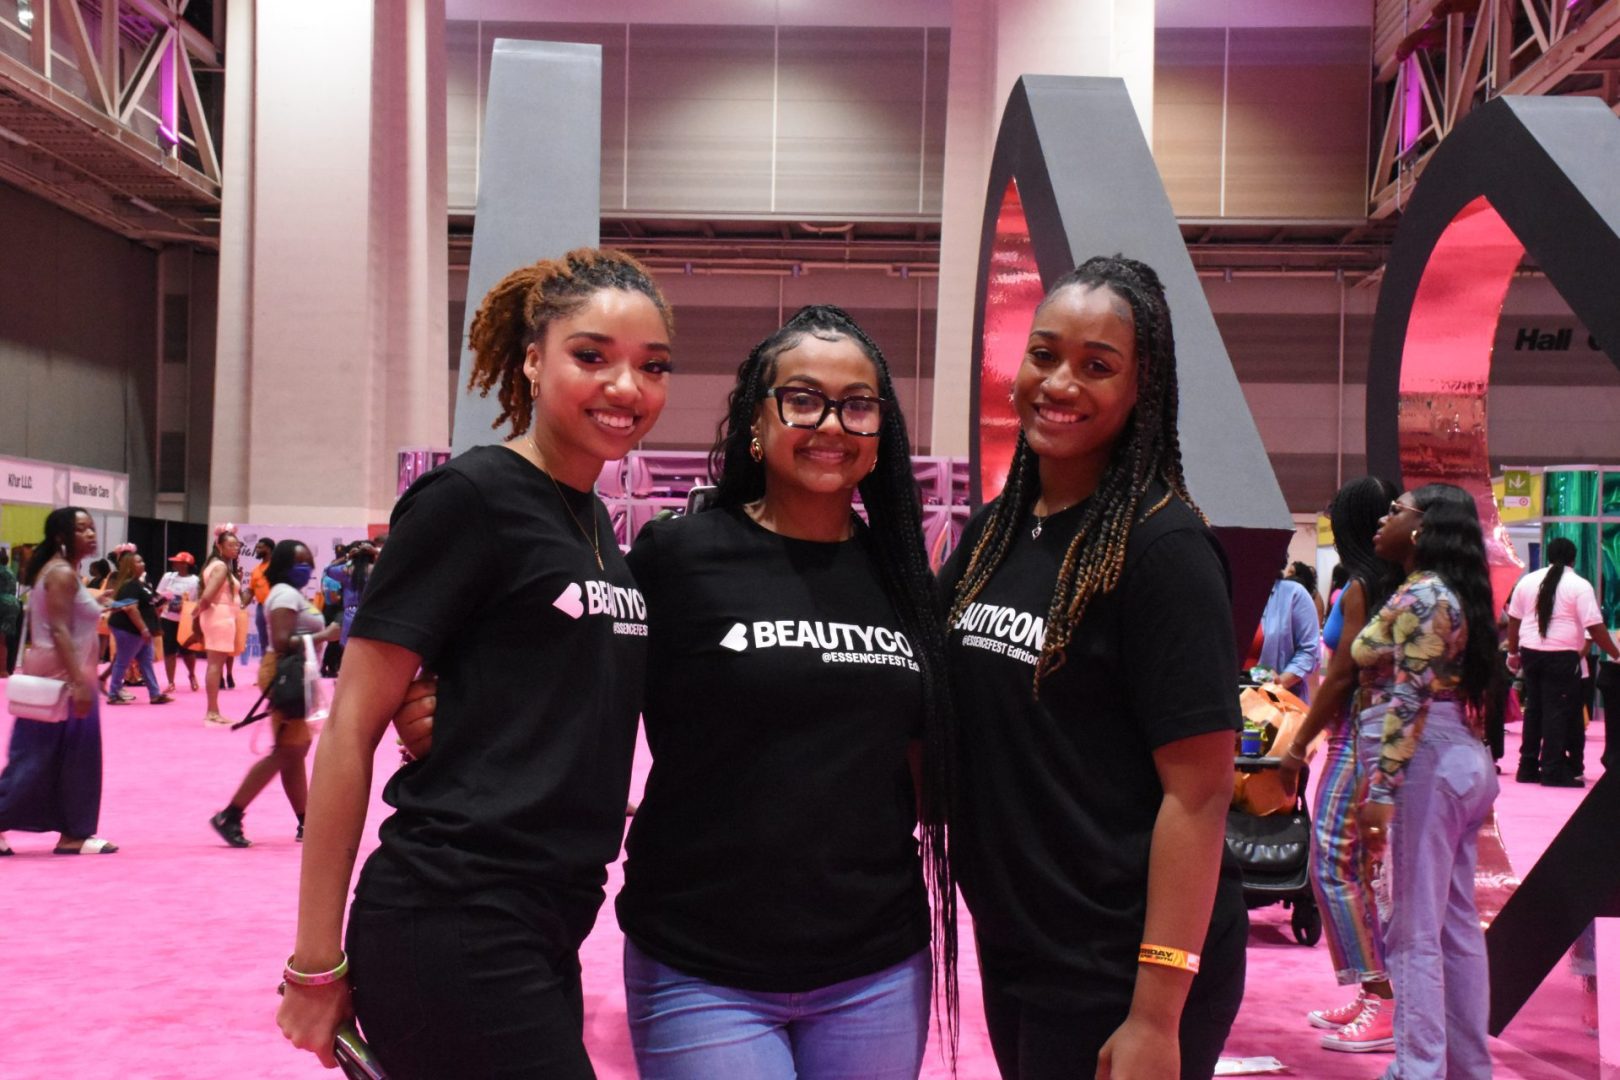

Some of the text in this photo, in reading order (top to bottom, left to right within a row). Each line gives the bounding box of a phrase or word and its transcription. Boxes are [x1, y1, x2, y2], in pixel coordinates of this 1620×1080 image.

[1514, 328, 1573, 351] Hall
[21, 475, 33, 489] LLC
[98, 485, 110, 499] Care
[585, 580, 648, 621] BEAUTYC
[962, 634, 1008, 655] @ESSENCEFEST
[821, 652, 907, 668] @ESSENCEFEST
